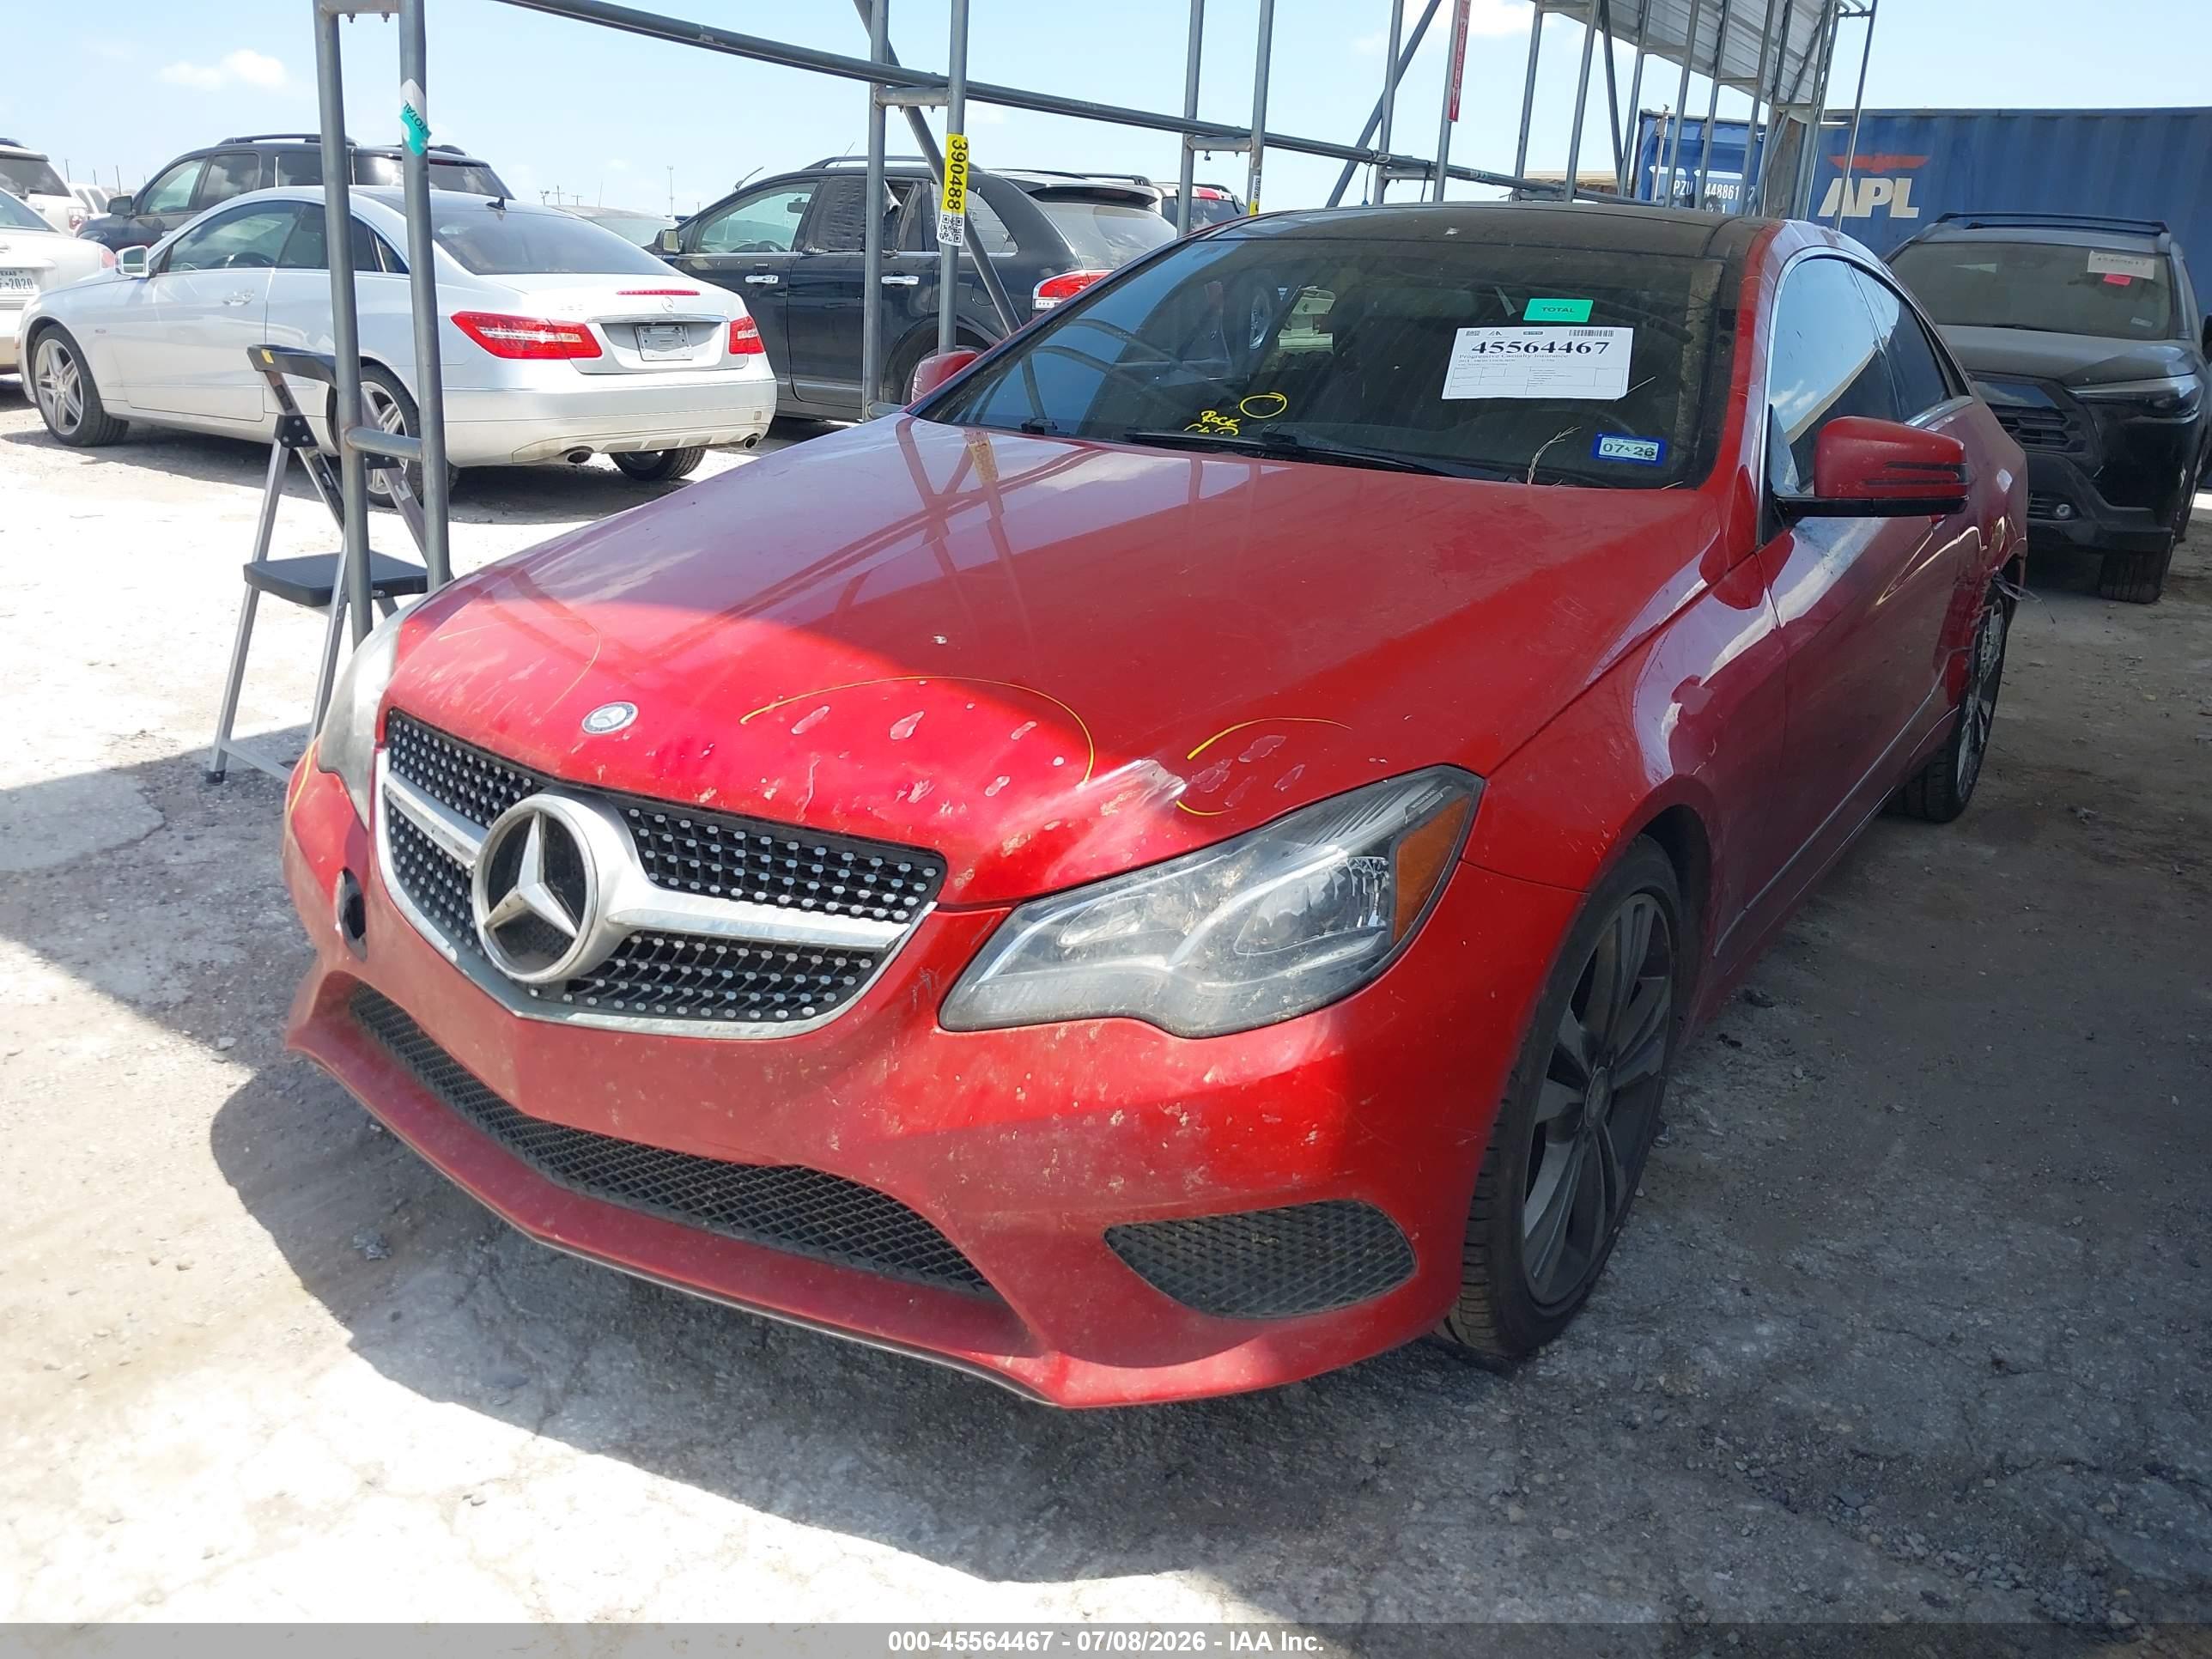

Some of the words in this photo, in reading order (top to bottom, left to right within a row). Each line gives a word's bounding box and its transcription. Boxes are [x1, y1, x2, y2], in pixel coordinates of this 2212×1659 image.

[946, 139, 969, 210] 390488
[1705, 183, 1740, 200] 448861
[1818, 178, 1920, 218] APL
[1471, 340, 1611, 355] 45564467
